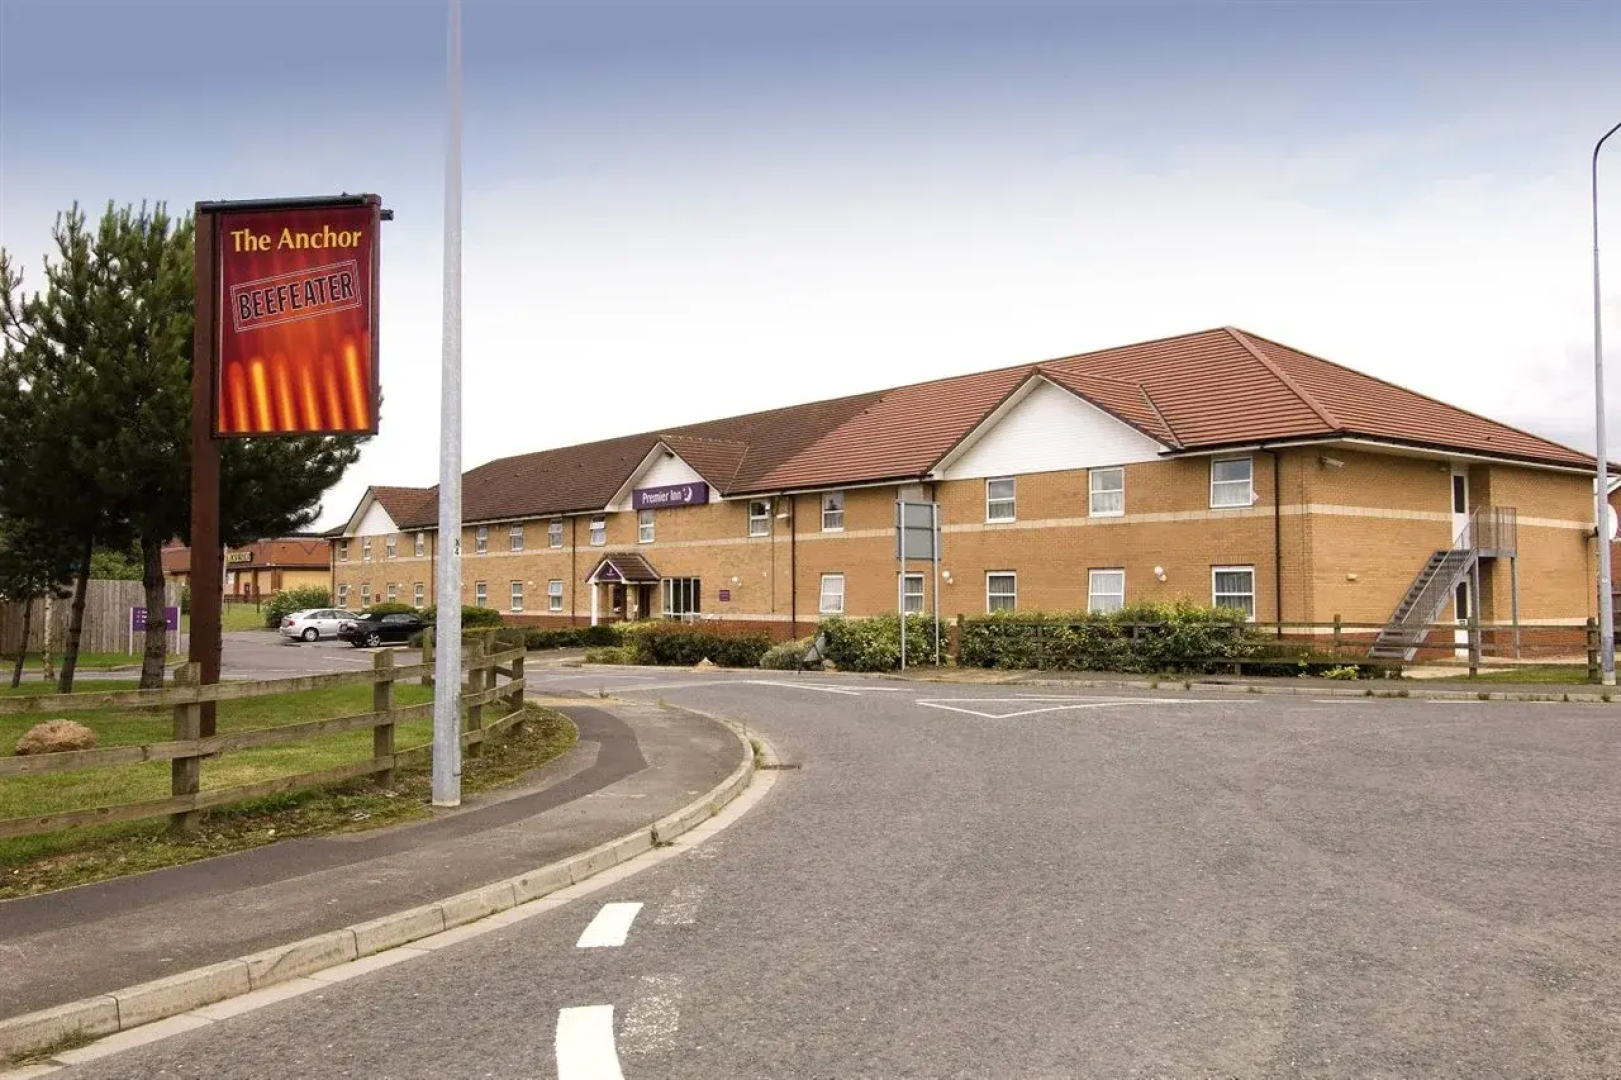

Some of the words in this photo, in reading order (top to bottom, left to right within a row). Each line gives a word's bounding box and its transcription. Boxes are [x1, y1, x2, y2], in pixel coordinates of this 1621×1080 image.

[231, 228, 271, 252] The
[277, 225, 362, 249] Anchor
[238, 272, 354, 320] BEEFEATER
[642, 491, 669, 505] Premier
[670, 489, 682, 501] Inn
